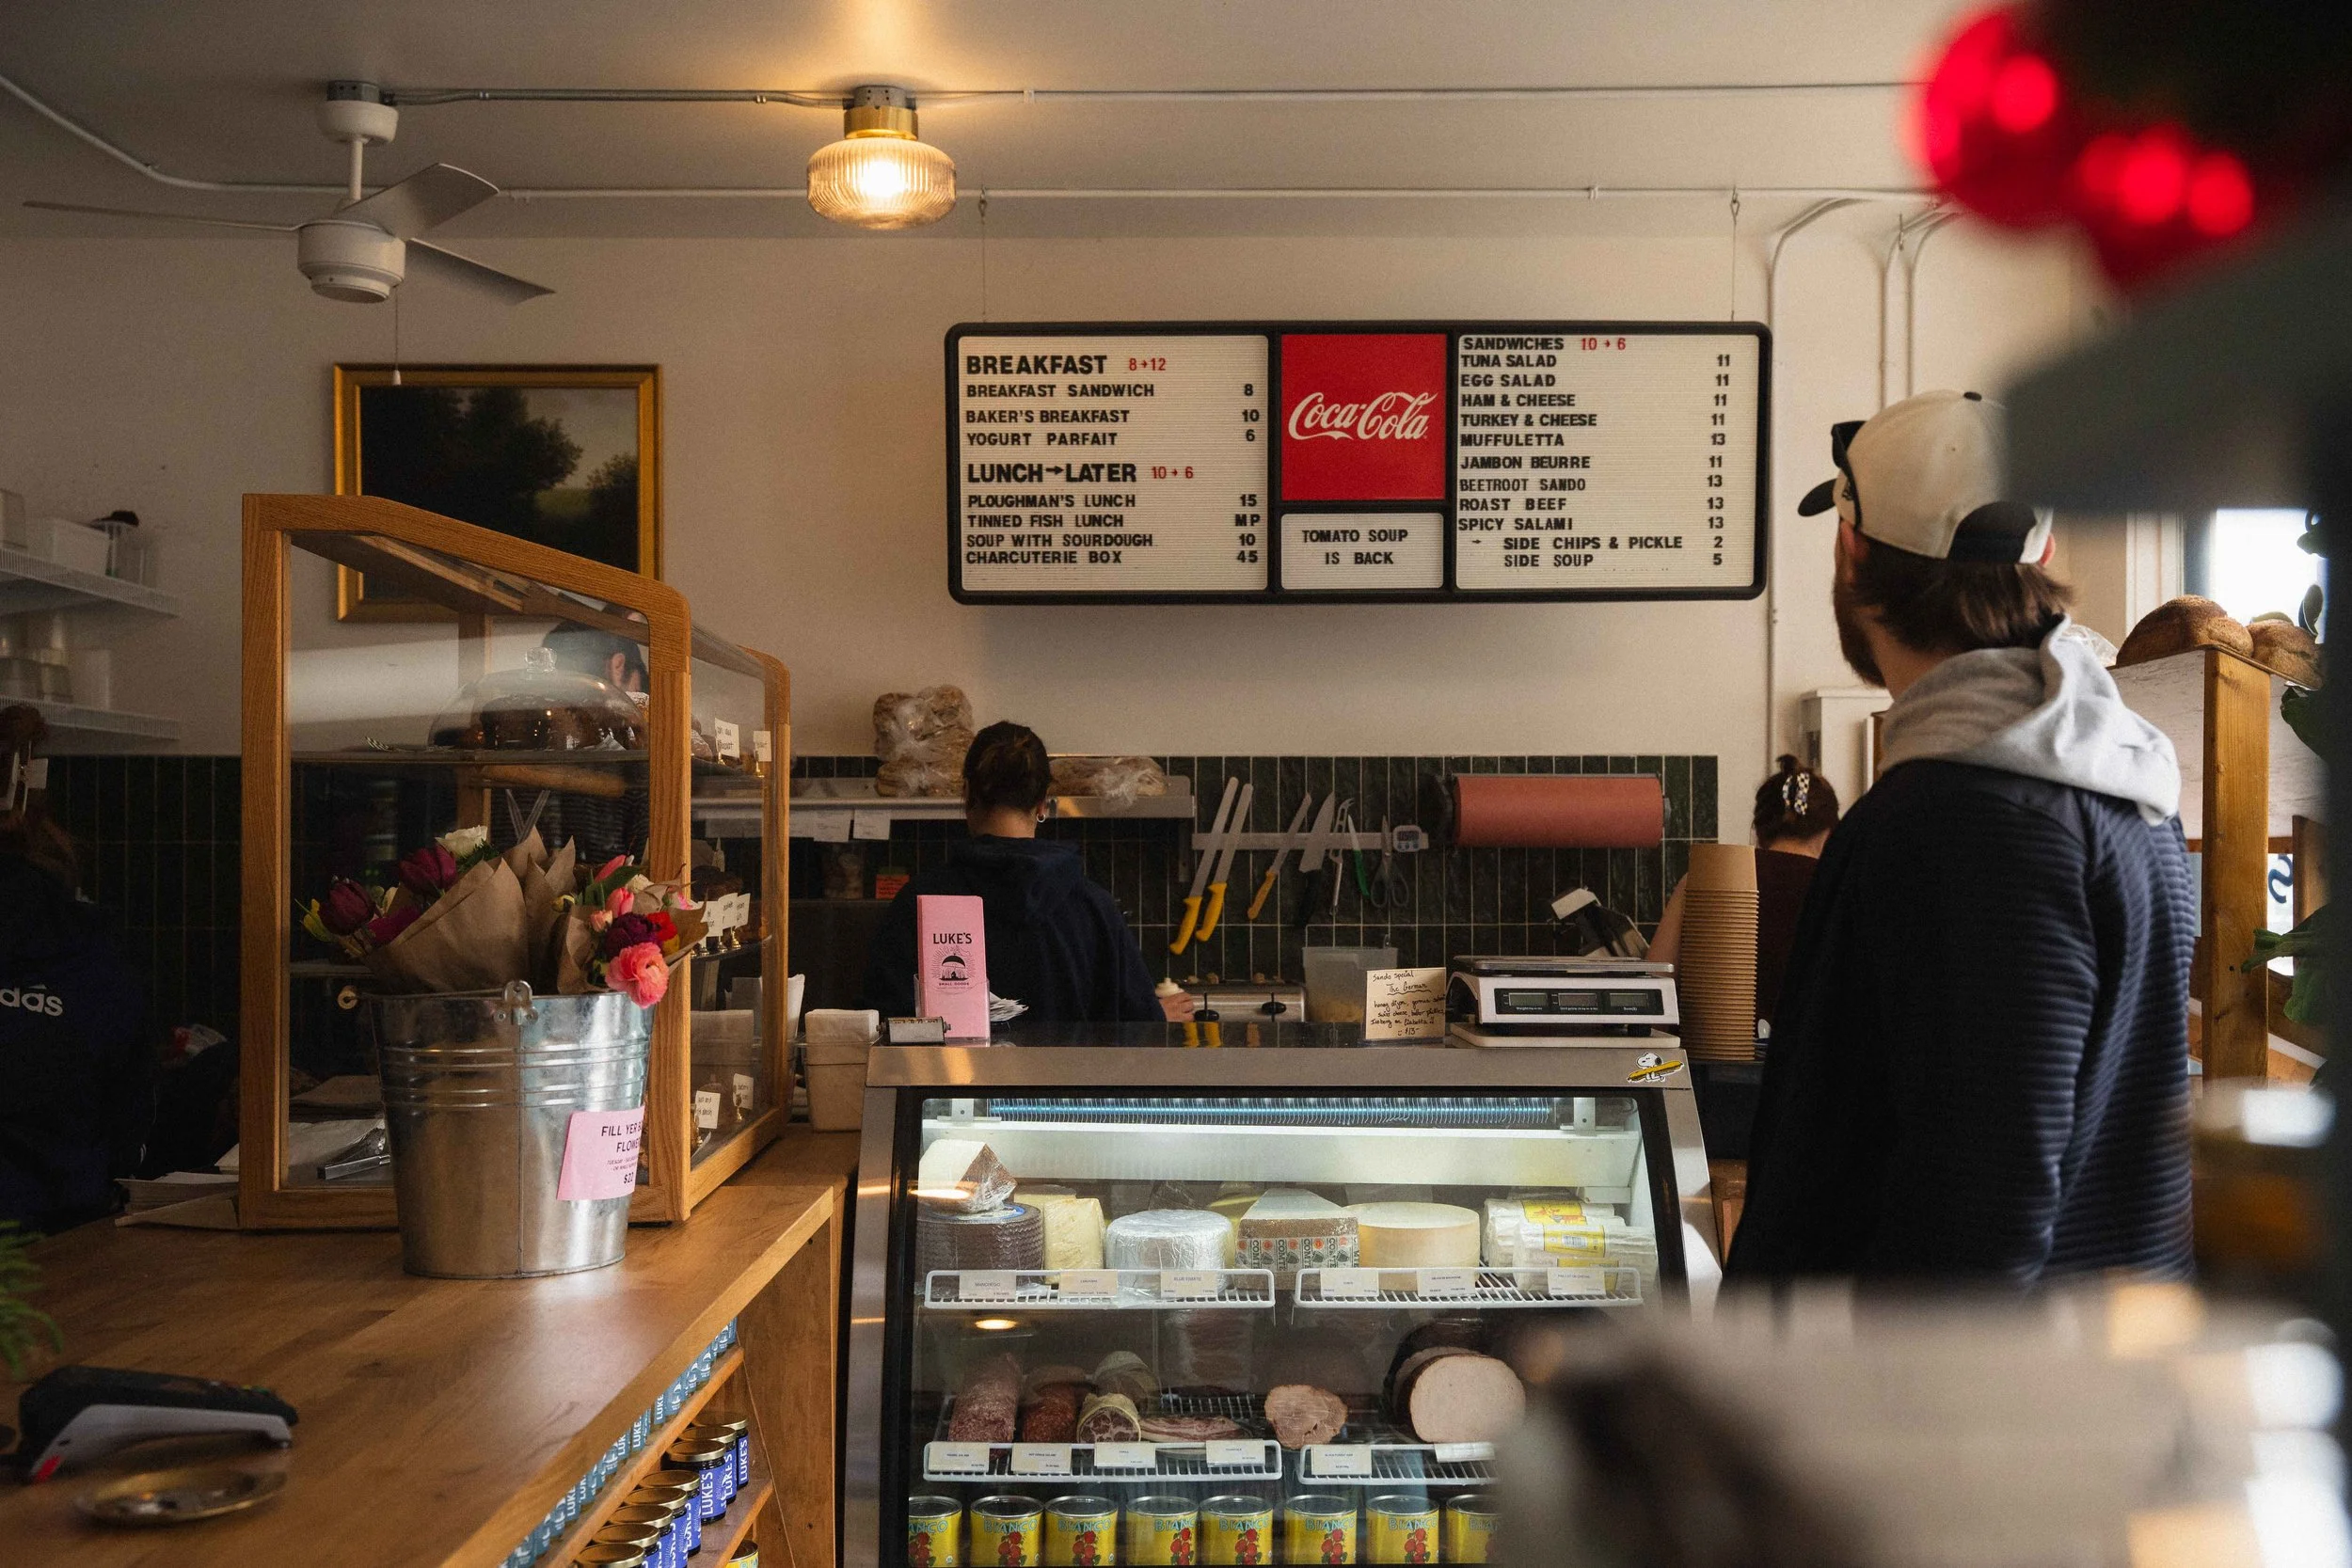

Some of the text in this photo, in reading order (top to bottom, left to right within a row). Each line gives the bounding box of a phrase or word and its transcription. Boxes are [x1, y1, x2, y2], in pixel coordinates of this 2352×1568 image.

[1464, 338, 1626, 350] SANDWICHES 10 6
[967, 356, 1166, 374] BREAKFAST 8 12
[1461, 355, 1729, 367] TUNA SALAD 11
[1461, 374, 1728, 387] EGG SALAD 11
[967, 384, 1253, 397] BREAKFAST SANDWICH 8
[1462, 394, 1726, 406] HAM & CHEESE 11
[966, 409, 1260, 423] BAKER'S BREAKFAST 10
[1289, 391, 1438, 440] Coca-Cola
[1461, 414, 1724, 426] TURKEY & CHEESE 11
[967, 429, 1255, 446] YOGURT PARFAIT 6
[1460, 434, 1725, 446] MUFFULETTA 13
[1461, 455, 1722, 469] JAMBON BEURRE 11
[968, 464, 1193, 483] LUNCH LATER 10 6
[1459, 475, 1722, 491] BEETROOT SANDO 13
[968, 494, 1257, 508] PLOUGHMAN'S LUNCH 15
[1460, 497, 1724, 511] ROAST BEEF 13
[967, 514, 1261, 527] TINNED FISH LUNCH MP
[1458, 516, 1724, 531] SPICY SALAMI 13
[967, 533, 1256, 547] SOUP WITH SOURDOUGH 10
[1302, 530, 1407, 543] TOMATO SOUP
[1503, 536, 1723, 549] SIDE CHIPS & PICKLE 2
[966, 550, 1258, 563] CHARCUTERIE BOX 45
[1326, 552, 1393, 564] IS BACK
[1504, 553, 1722, 567] SIDE SOUP 5
[932, 932, 973, 944] LUKE'S
[1394, 970, 1414, 980] special
[1387, 981, 1427, 993] The German
[601, 1125, 622, 1136] FILL
[701, 1471, 713, 1516] LUKE'S
[984, 1519, 1037, 1533] BIANCO
[1057, 1518, 1110, 1531] BIANCO
